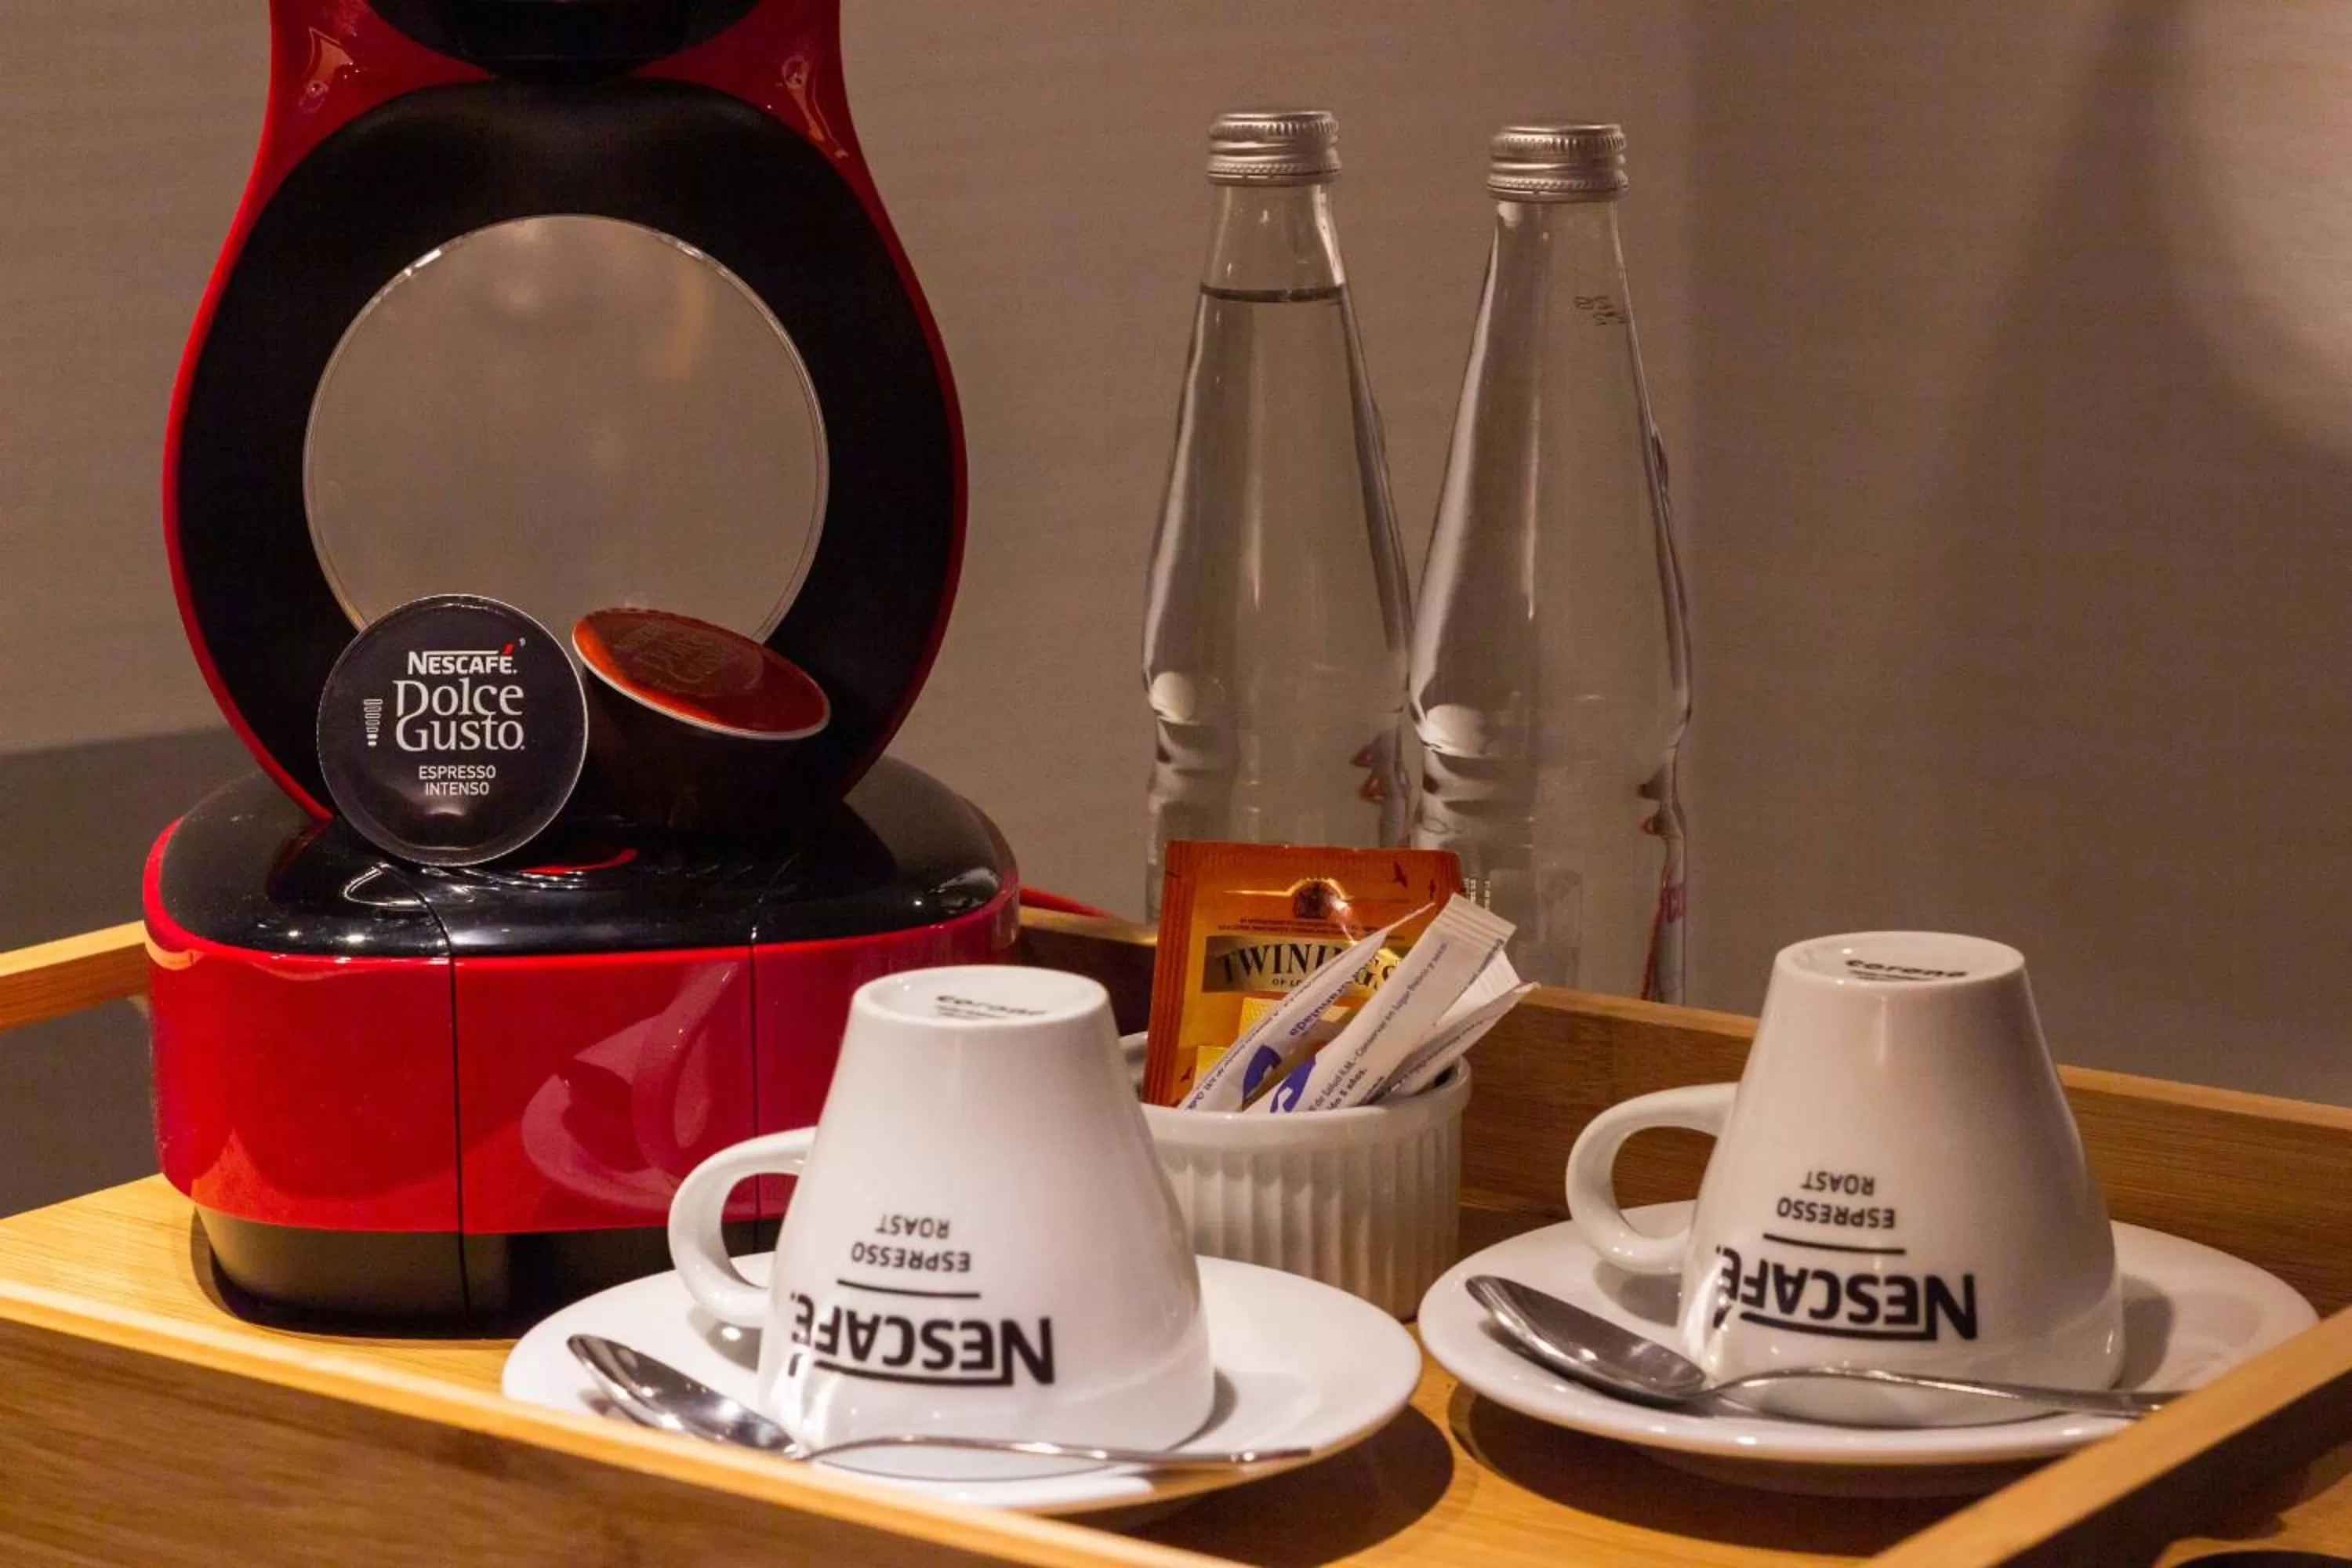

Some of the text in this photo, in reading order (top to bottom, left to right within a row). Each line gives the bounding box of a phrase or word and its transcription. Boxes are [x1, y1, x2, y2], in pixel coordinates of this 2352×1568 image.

[393, 677, 524, 717] Dolce
[419, 764, 497, 779] ESPRESSO
[426, 782, 490, 797] INTENSO
[1218, 943, 1396, 991] TWINIG
[1801, 1171, 1875, 1196] ROAST
[876, 1214, 950, 1239] ROAST
[1777, 1197, 1896, 1229] ESPRESSO
[851, 1241, 971, 1272] ESPRESSO
